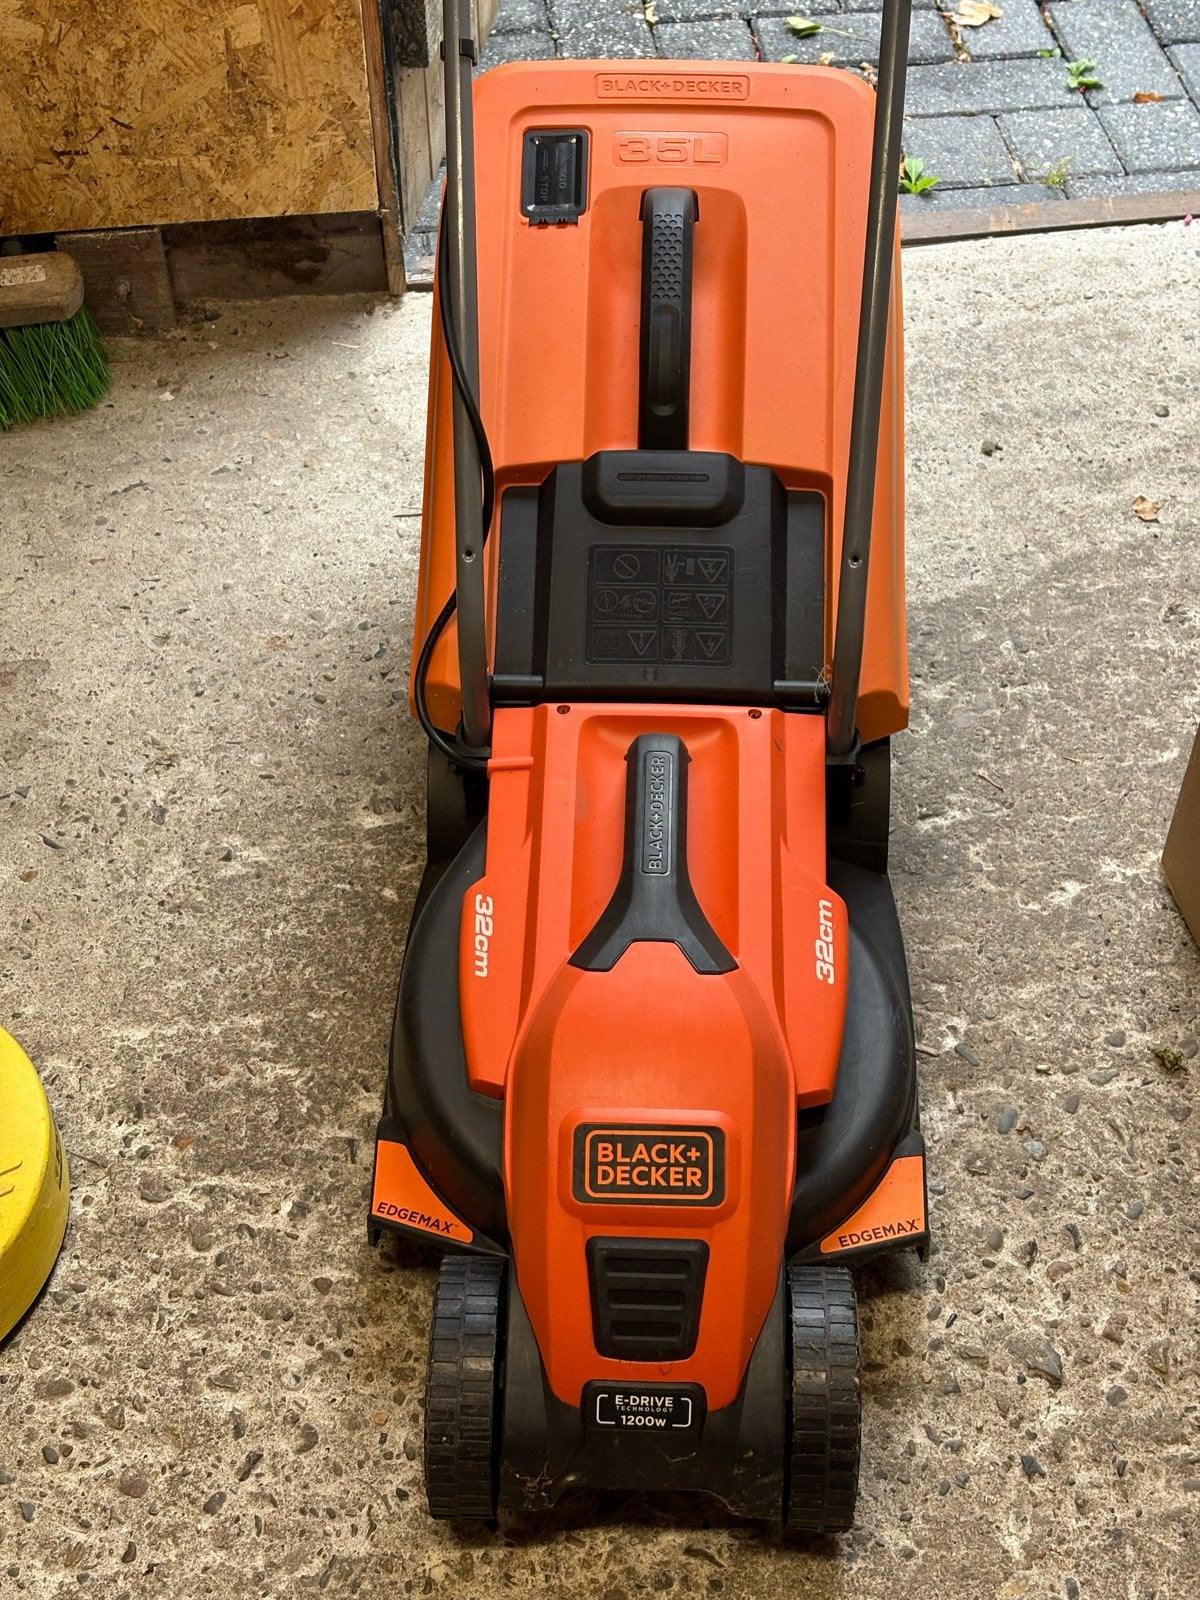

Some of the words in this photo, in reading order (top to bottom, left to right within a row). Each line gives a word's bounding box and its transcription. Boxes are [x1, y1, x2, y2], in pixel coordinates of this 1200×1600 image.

[602, 79, 743, 94] BLACK+DECKER
[619, 136, 721, 163] 35L
[540, 175, 549, 202] STOP
[648, 756, 665, 869] BLACK+DECKER
[474, 893, 494, 978] 32cm
[815, 899, 835, 985] 32cm
[597, 1142, 701, 1164] BLACK+
[597, 1165, 702, 1187] DECKER
[376, 1201, 454, 1234] EDGEMAX
[838, 1219, 920, 1248] EDGEMAX
[615, 1394, 674, 1407] E-DRIVE
[616, 1405, 674, 1413] TECHNOLOGY
